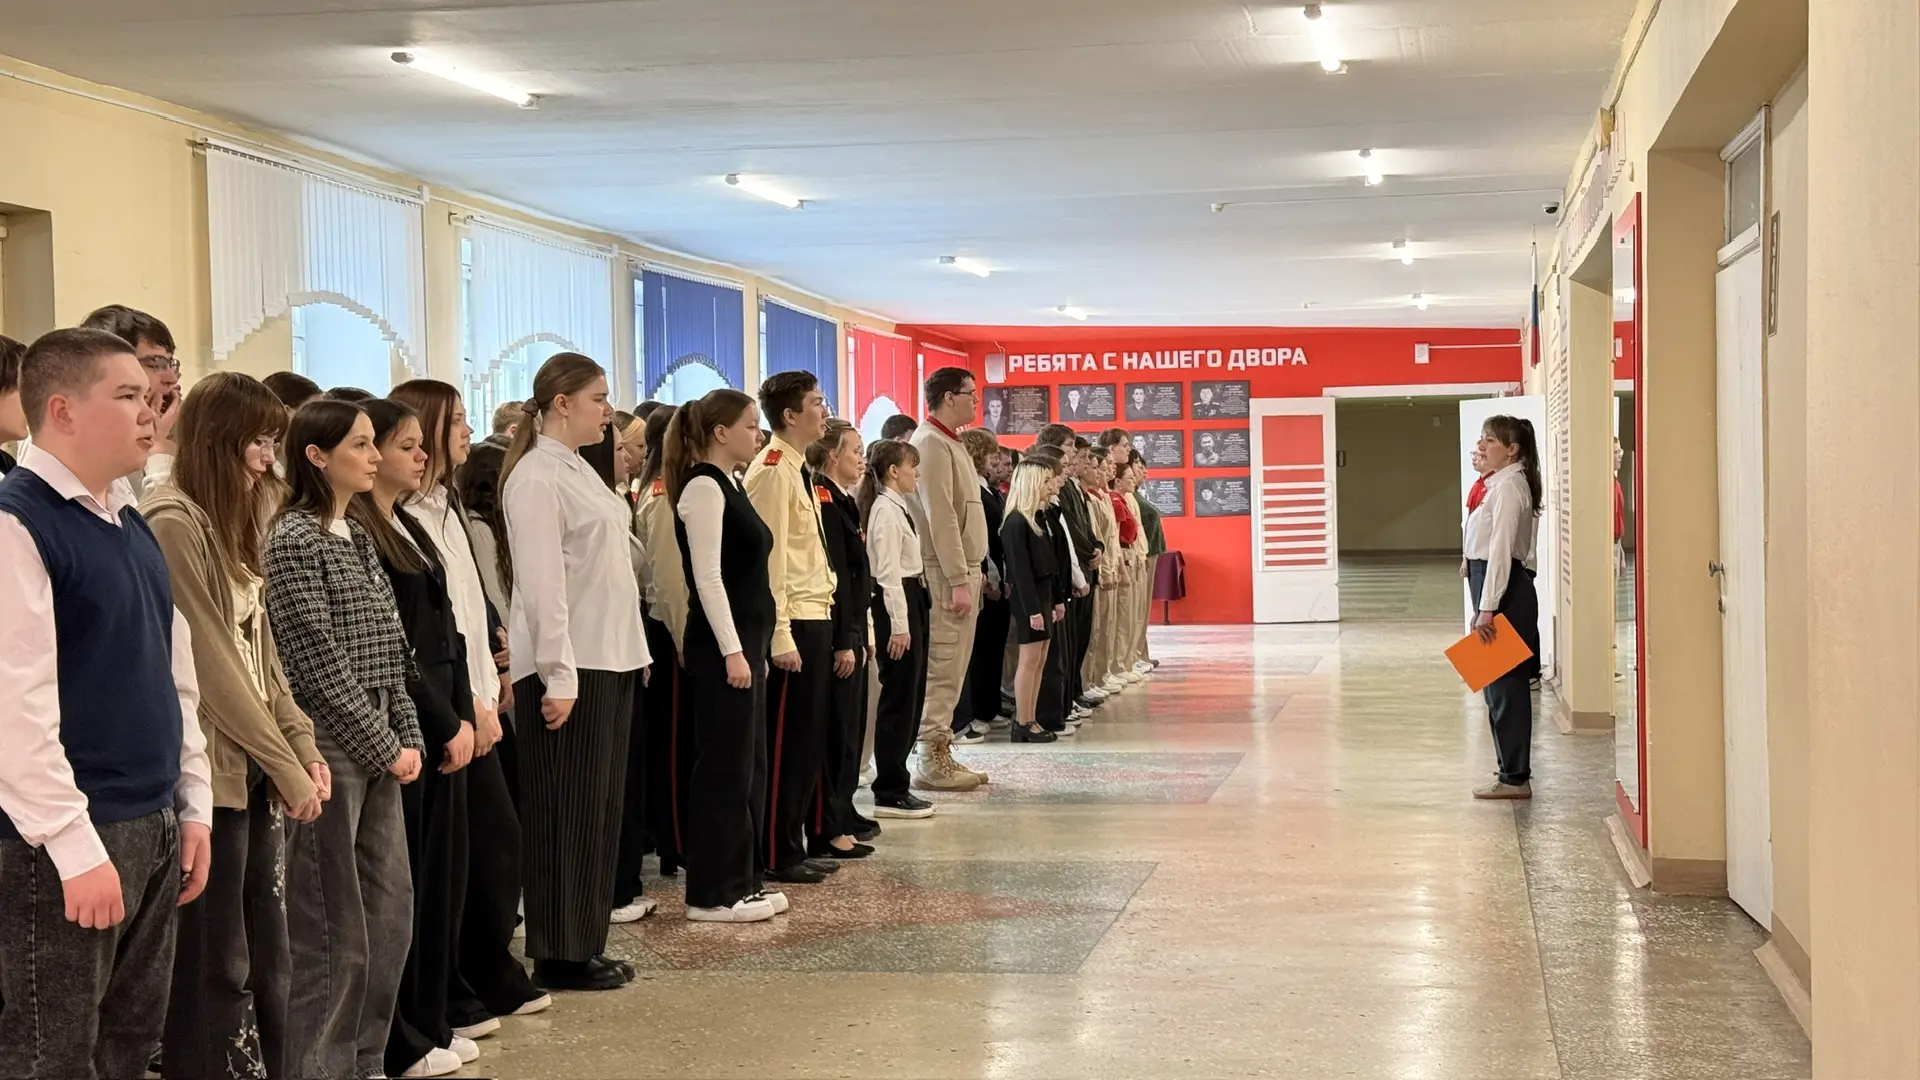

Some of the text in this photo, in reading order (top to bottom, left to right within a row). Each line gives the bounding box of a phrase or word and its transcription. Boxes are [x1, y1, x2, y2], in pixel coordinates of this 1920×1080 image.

[1008, 347, 1308, 373] РЕБЯТА С НАШЕГО ДВОРА
